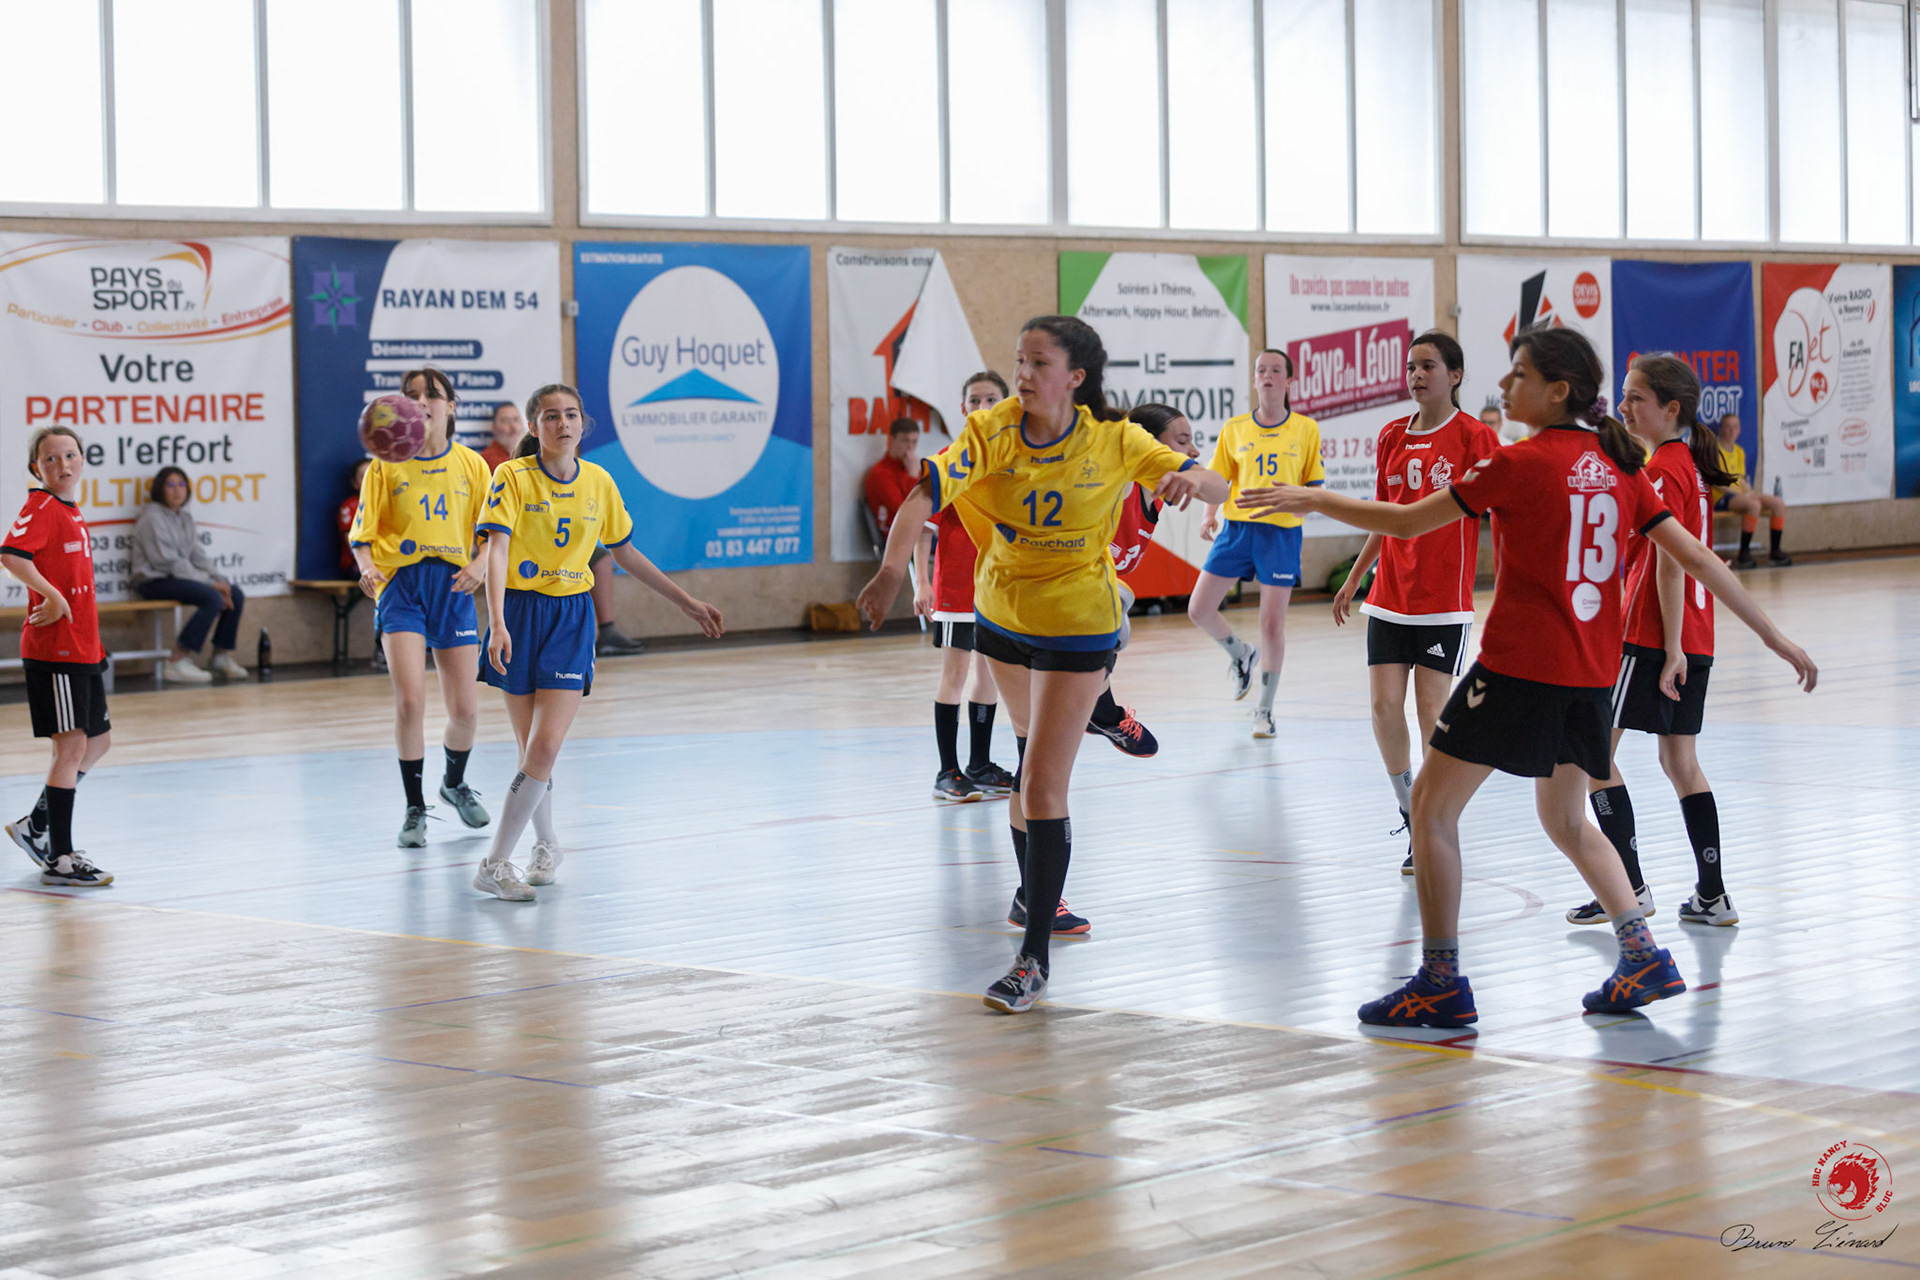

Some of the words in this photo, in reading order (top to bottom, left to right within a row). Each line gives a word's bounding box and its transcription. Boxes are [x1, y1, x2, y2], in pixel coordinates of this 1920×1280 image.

[836, 253, 909, 267] Construisons
[90, 267, 162, 288] PAYS
[1301, 274, 1328, 296] caviste
[1330, 279, 1343, 298] pas
[1345, 279, 1371, 297] comme
[1386, 277, 1409, 297] autres
[383, 289, 454, 309] RAYAN
[461, 290, 506, 310] DEM
[514, 292, 539, 310] 54
[1117, 282, 1150, 296] Soirées
[1848, 289, 1872, 300] RADIO
[93, 290, 184, 312] SPORT
[7, 302, 77, 329] Particulier
[92, 320, 123, 333] Club
[137, 317, 209, 333] Collectivité
[1082, 305, 1131, 319] Afterwork,
[1133, 306, 1162, 321] Happy
[371, 341, 474, 359] Déménagement
[621, 336, 669, 373] Guy
[676, 335, 766, 371] Hoquet
[100, 354, 194, 383] Votre
[1144, 353, 1166, 374] LE
[1300, 341, 1344, 400] Cave
[1355, 327, 1402, 387] Léon
[458, 372, 496, 387] Piano
[26, 393, 265, 425] PARTENAIRE
[710, 410, 767, 425] GARANTI
[118, 434, 233, 466] l'effort
[1342, 437, 1359, 458] 17
[1405, 442, 1433, 451] hummel
[1030, 452, 1065, 465] hummel
[1255, 453, 1278, 477] 15
[1407, 457, 1423, 490] 6
[551, 489, 575, 499] hummel
[419, 493, 449, 521] 14
[1022, 489, 1064, 527] 12
[554, 517, 571, 548] 5
[1565, 492, 1619, 583] 13
[555, 671, 583, 681] hummel
